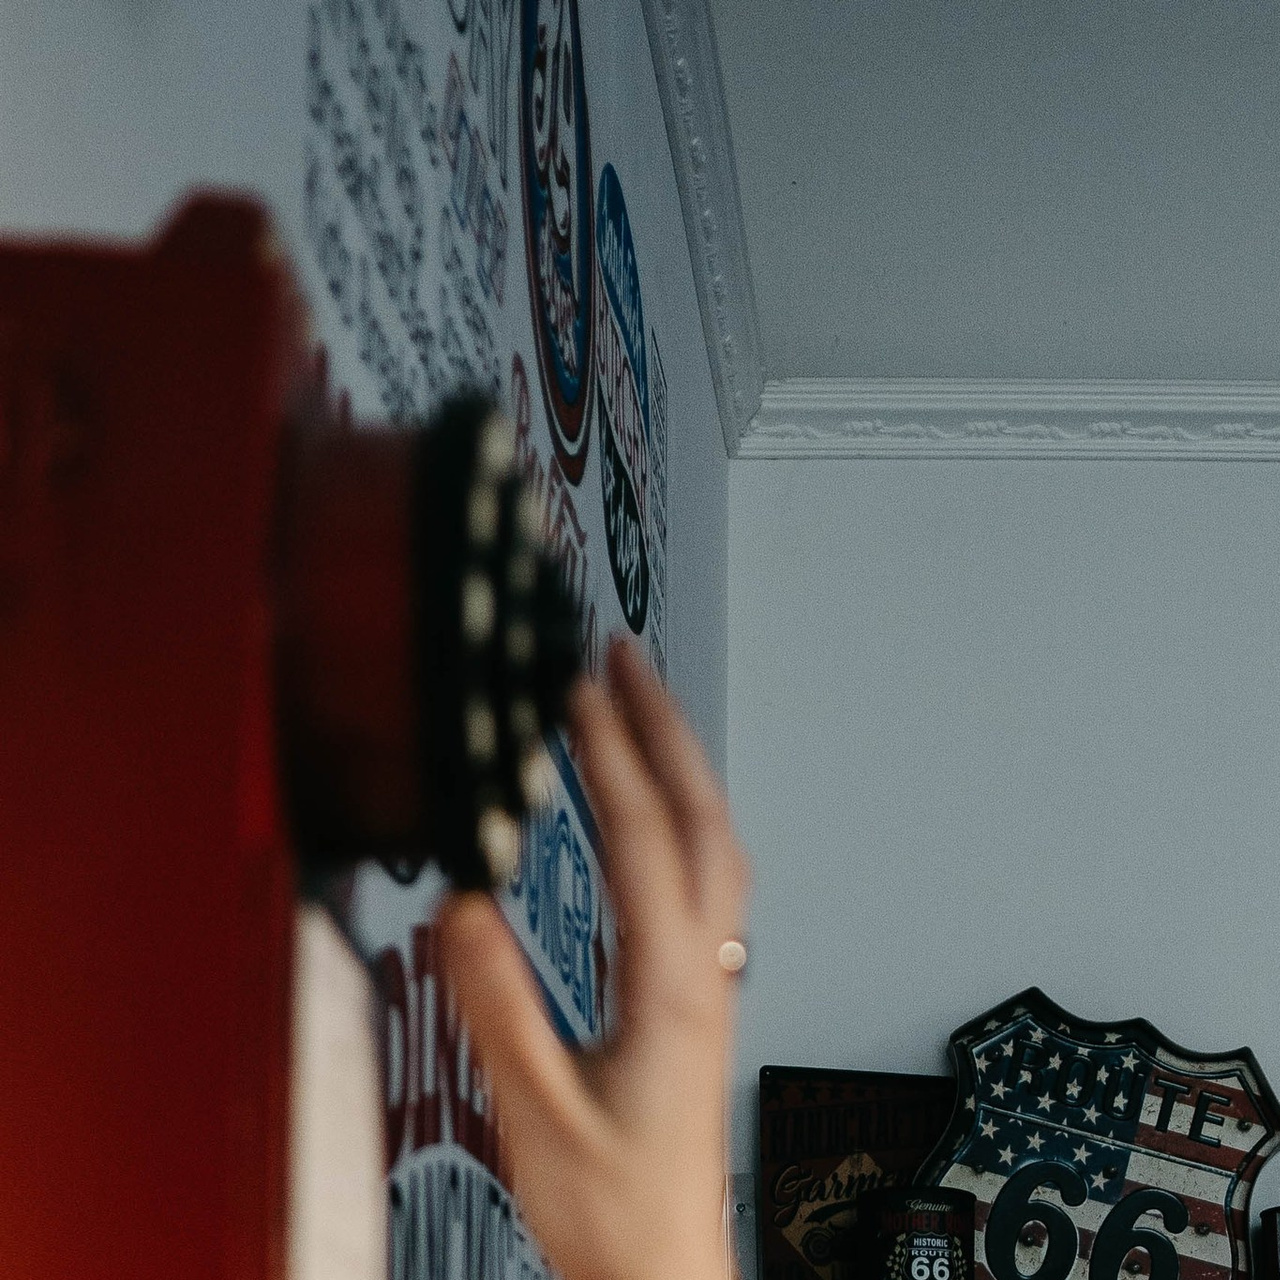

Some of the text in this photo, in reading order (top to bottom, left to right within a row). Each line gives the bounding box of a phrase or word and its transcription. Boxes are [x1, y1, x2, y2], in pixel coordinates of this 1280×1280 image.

[1005, 1039, 1232, 1148] ROUTE
[913, 1238, 949, 1248] HISTORIC
[911, 1249, 951, 1257] ROUTE
